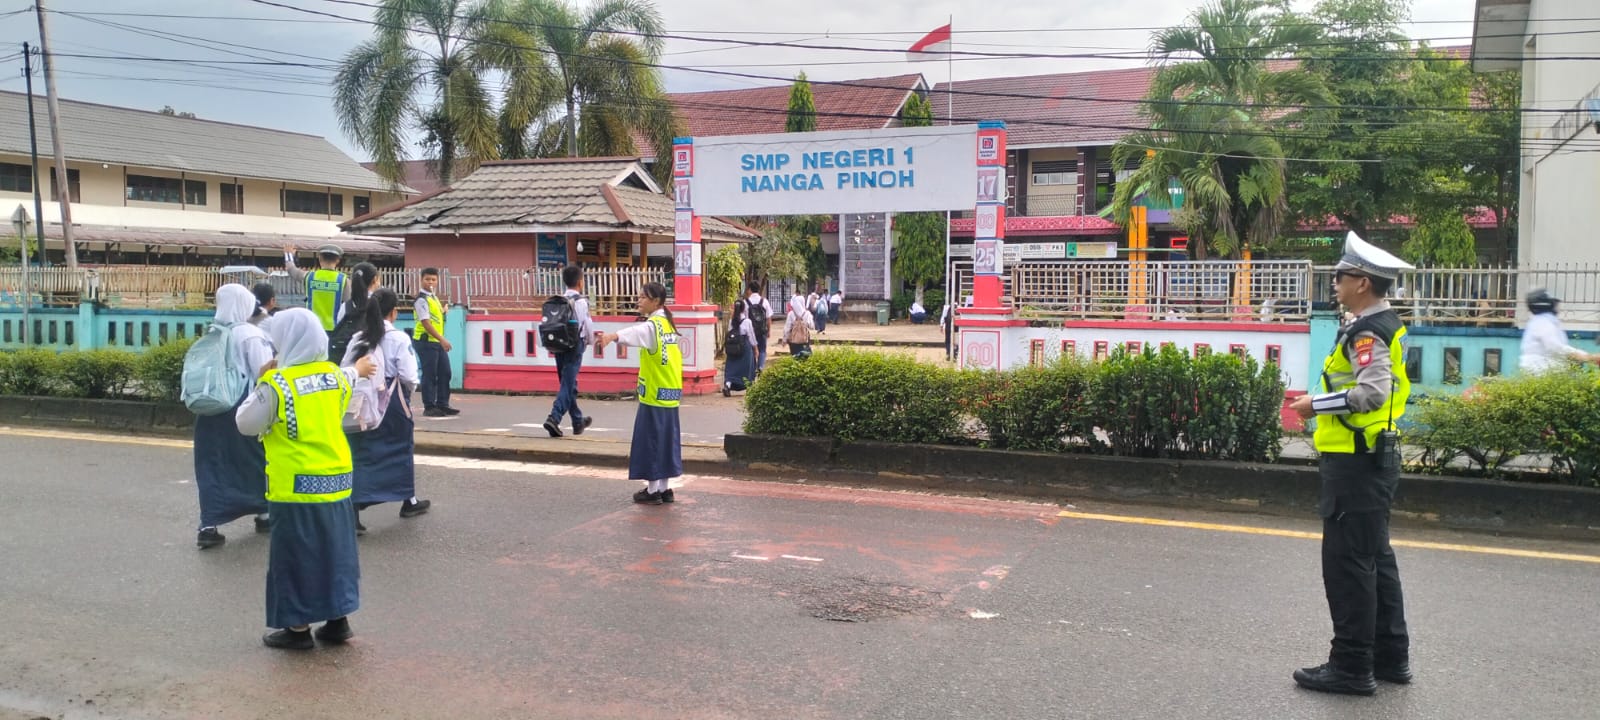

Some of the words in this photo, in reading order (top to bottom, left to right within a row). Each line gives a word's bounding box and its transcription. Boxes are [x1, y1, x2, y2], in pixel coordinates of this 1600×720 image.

[741, 153, 790, 171] SMP
[802, 147, 894, 170] NEGERI
[903, 146, 913, 165] 1
[741, 173, 824, 193] NANGA
[837, 169, 914, 190] PINOH
[979, 175, 997, 196] 17
[675, 184, 689, 206] 17
[675, 250, 691, 268] 45
[976, 247, 995, 267] 25
[967, 342, 993, 367] 00
[295, 373, 337, 390] PKS
